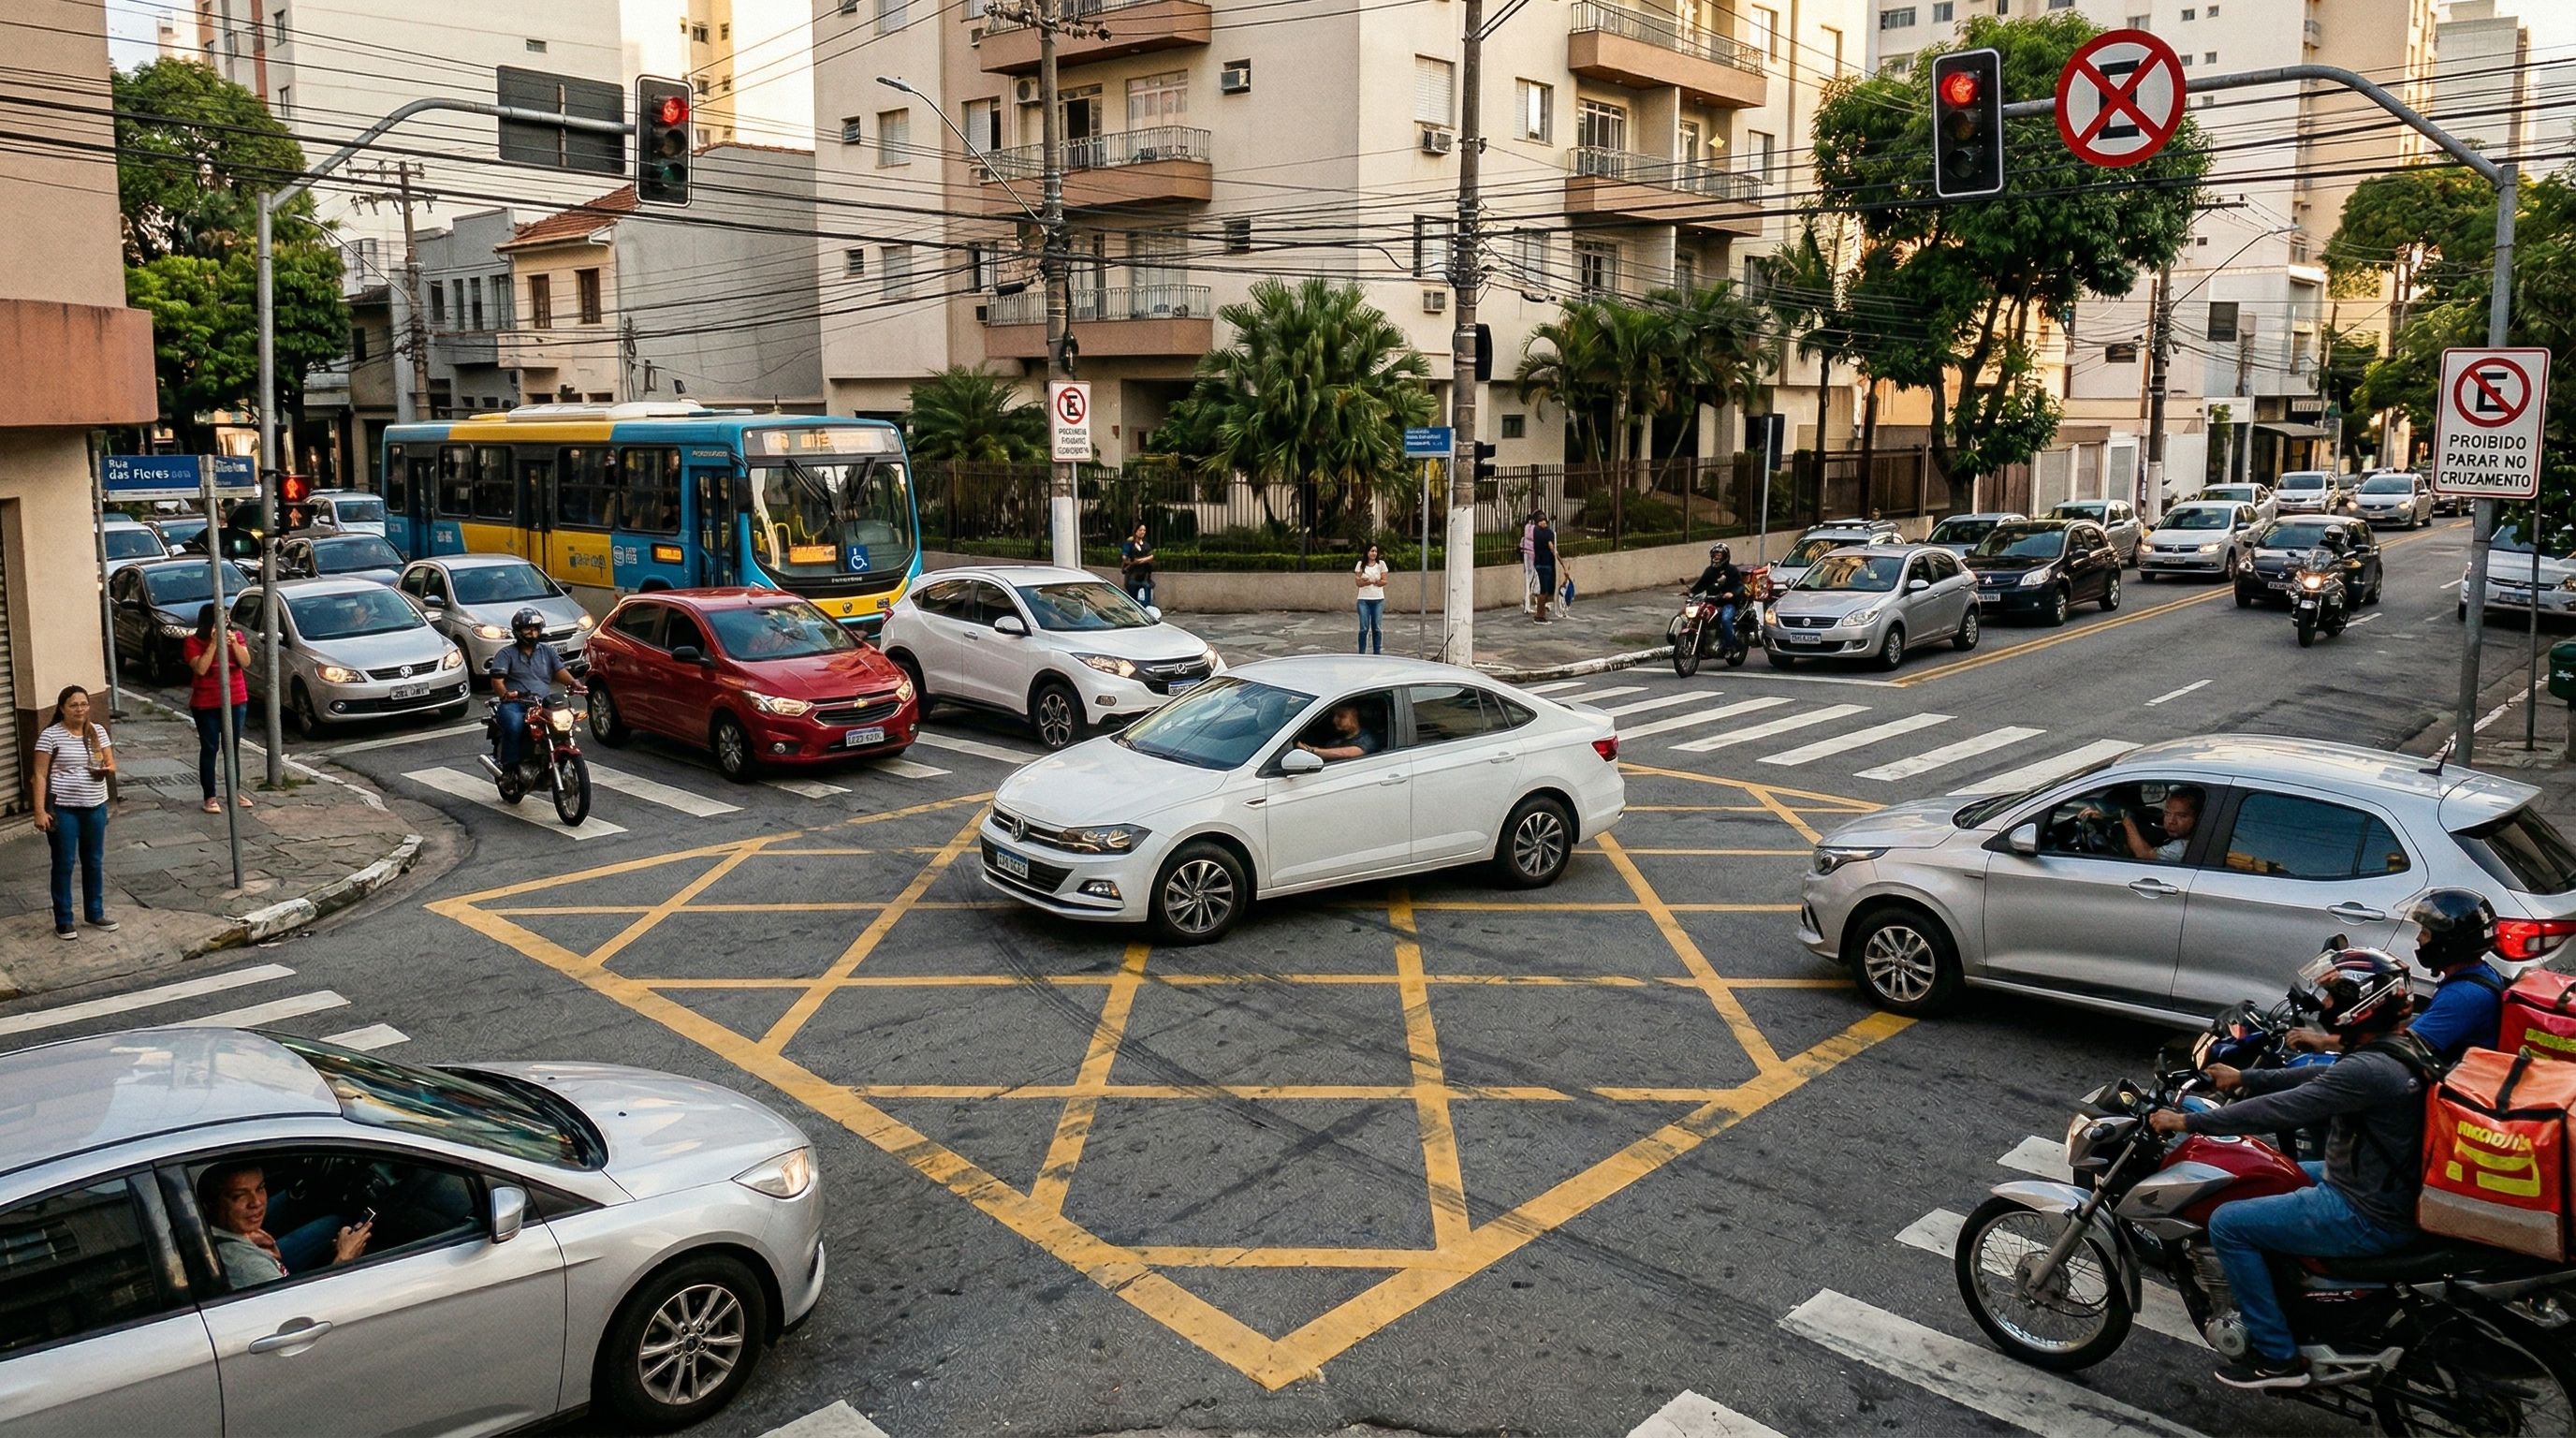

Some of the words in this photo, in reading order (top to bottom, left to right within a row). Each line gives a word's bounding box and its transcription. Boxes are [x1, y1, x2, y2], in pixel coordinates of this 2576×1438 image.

[2449, 434, 2527, 449] PROIBIDO
[109, 460, 128, 468] Rua
[2446, 453, 2498, 468] PARAR
[2505, 455, 2527, 469] NO
[109, 469, 130, 479] das
[2440, 471, 2531, 488] CRUZAMENTO
